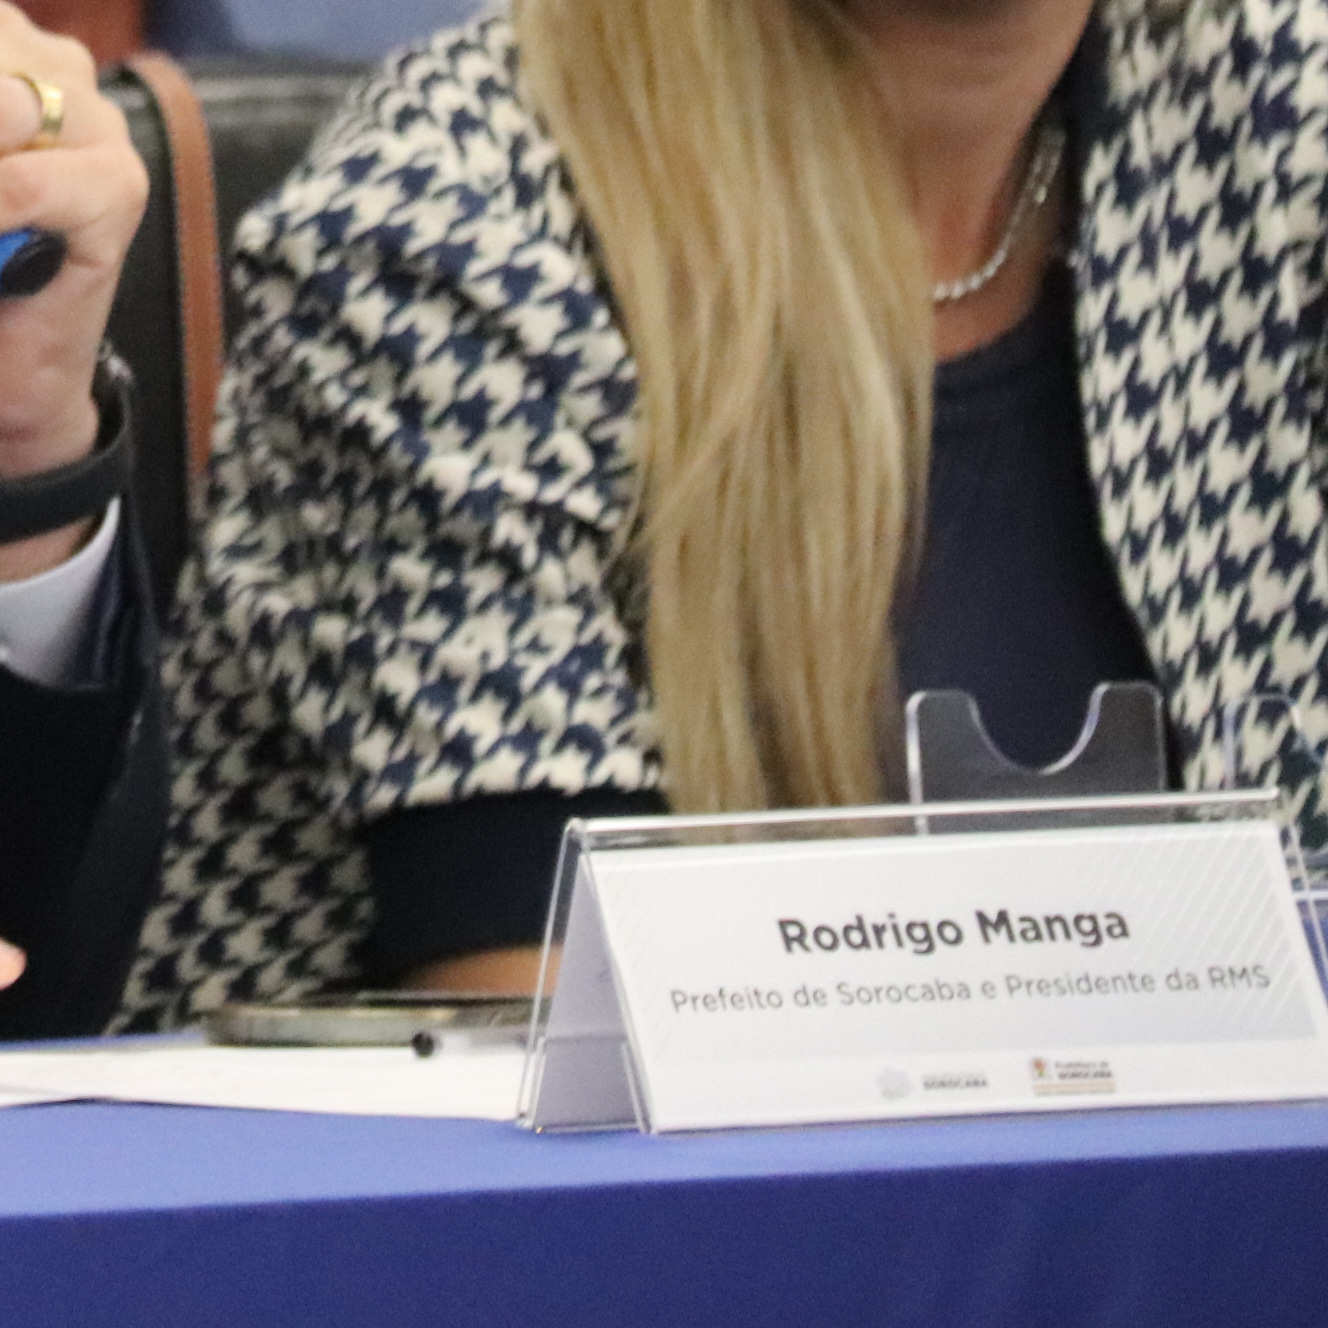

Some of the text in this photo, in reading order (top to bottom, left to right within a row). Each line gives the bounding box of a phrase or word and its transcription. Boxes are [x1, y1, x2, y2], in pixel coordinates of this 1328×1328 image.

[777, 908, 1130, 956] Rodrigo Manga
[669, 963, 1271, 1013] Prefeito de Sorocaba e Presidente da RMS
